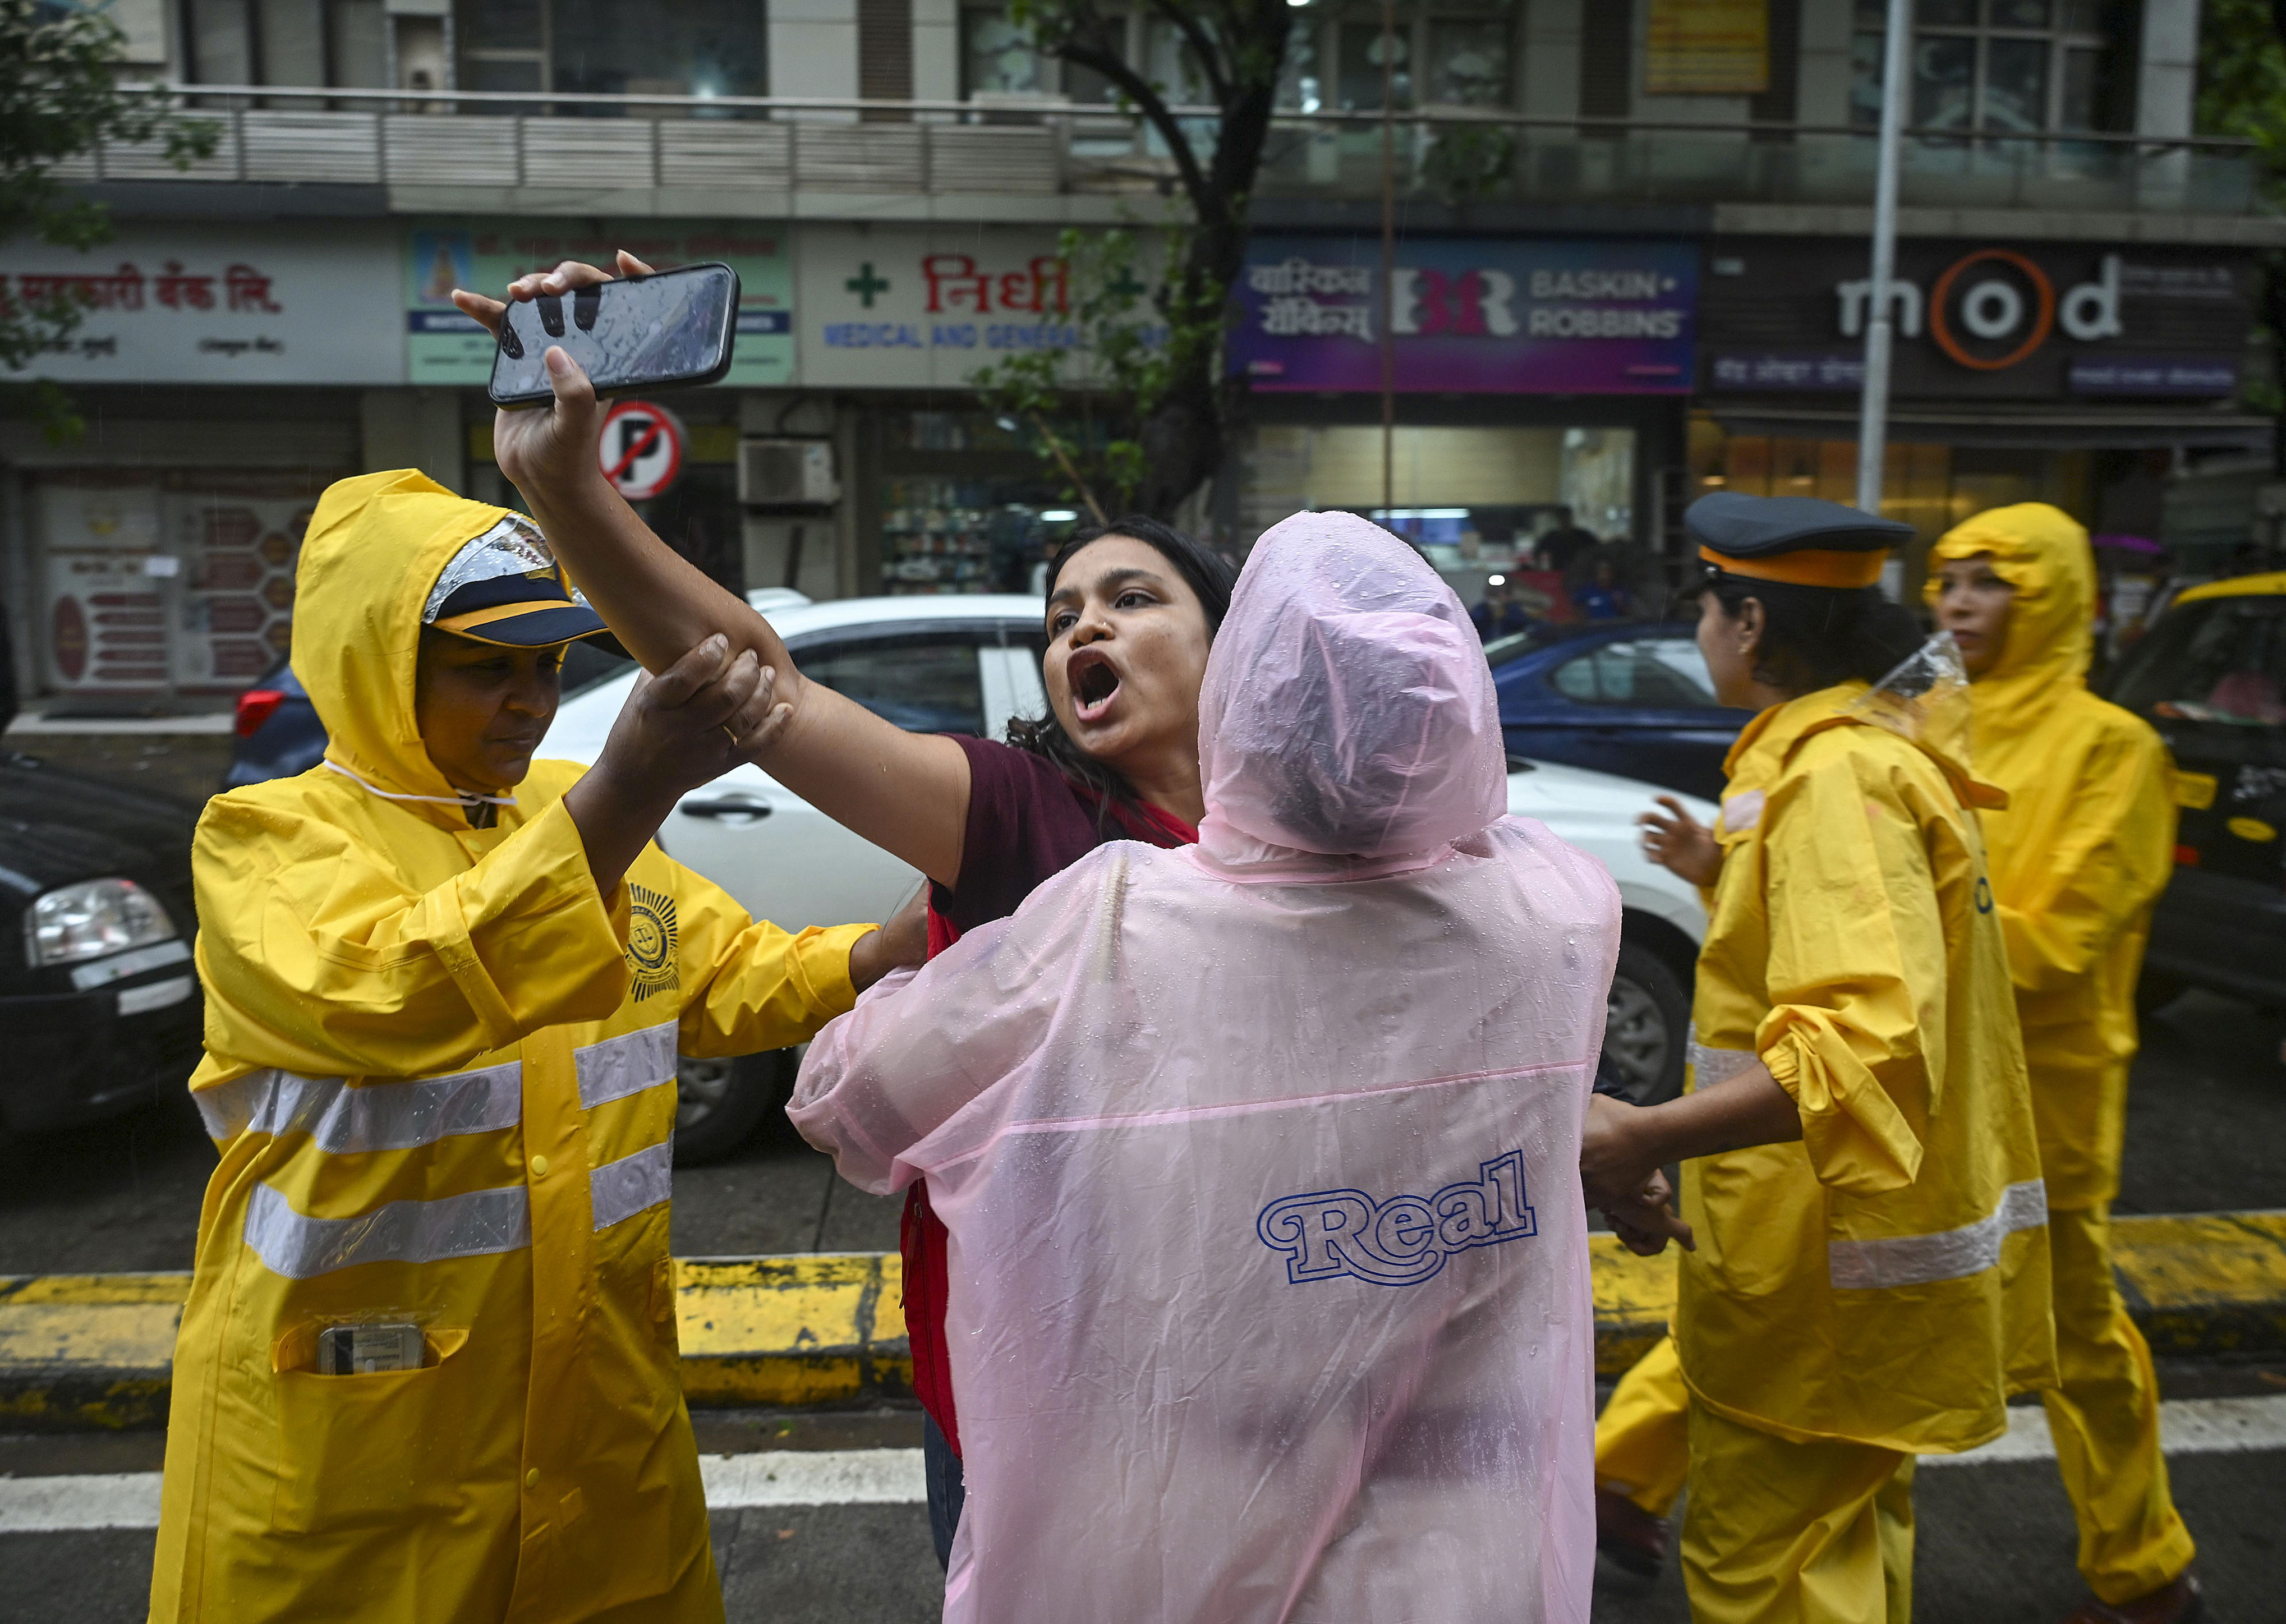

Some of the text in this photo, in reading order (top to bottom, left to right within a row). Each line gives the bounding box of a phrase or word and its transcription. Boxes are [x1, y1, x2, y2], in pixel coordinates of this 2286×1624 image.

[1530, 269, 1657, 300] BASKIN
[1836, 255, 2122, 339] mod
[823, 322, 923, 348] MEDICAL
[933, 323, 977, 348] AND
[1530, 308, 1678, 339] ROBBINS
[621, 419, 660, 482] P
[1257, 1149, 1538, 1287] Real
